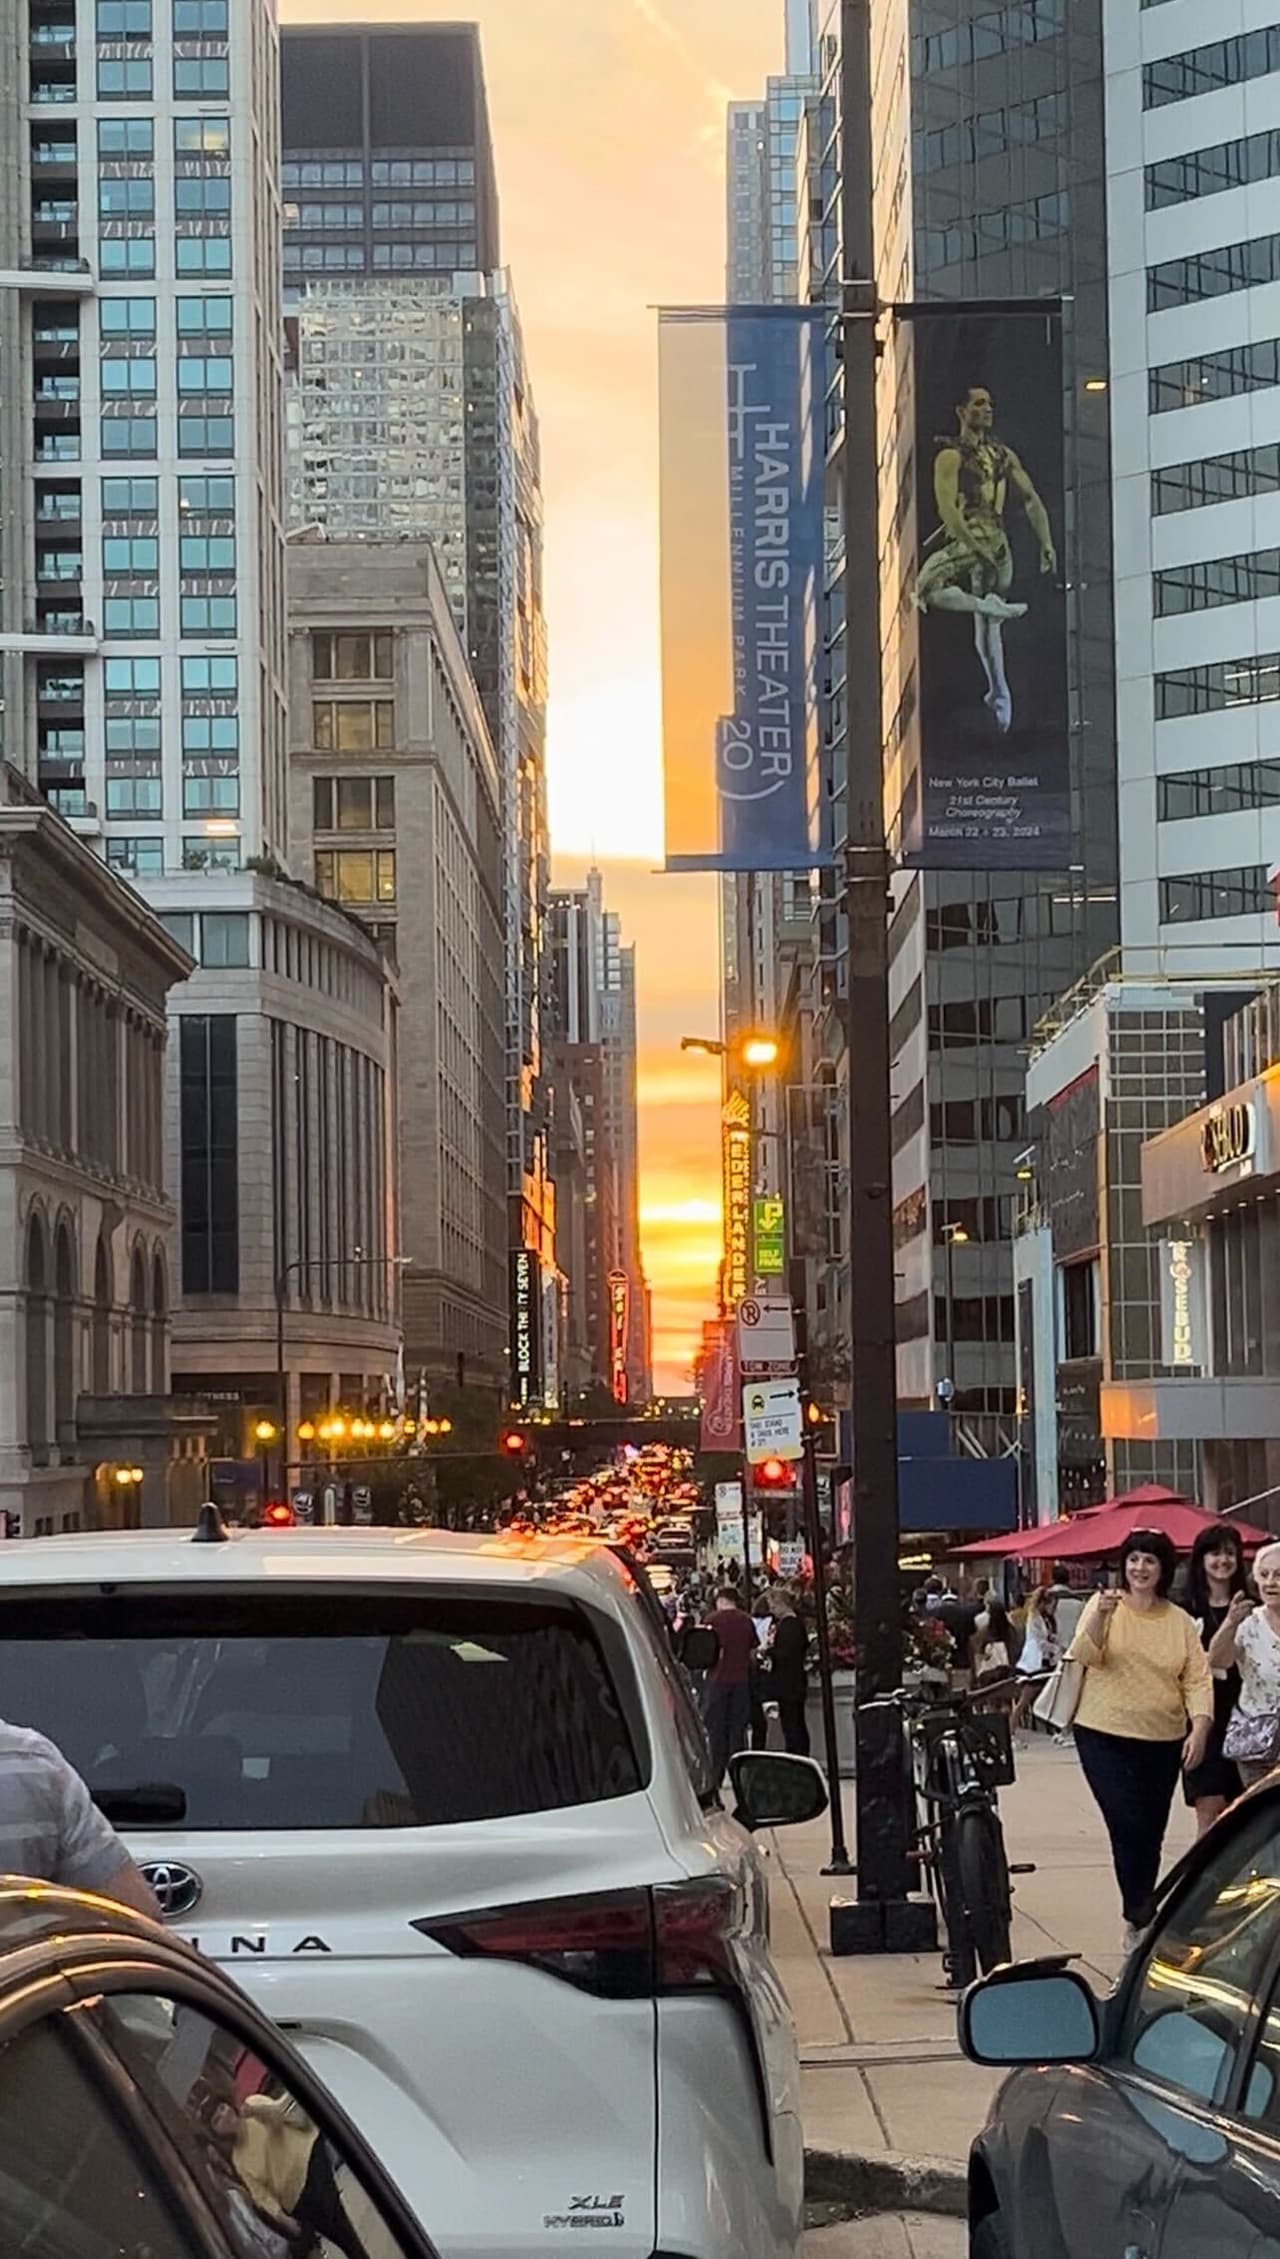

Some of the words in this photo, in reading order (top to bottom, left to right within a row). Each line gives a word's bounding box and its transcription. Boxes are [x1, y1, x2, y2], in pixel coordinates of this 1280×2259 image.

[754, 423, 790, 589] HARRIS
[730, 466, 745, 621] MILLENNIUM
[732, 635, 747, 696] PARK
[755, 595, 792, 777] THEATER
[929, 777, 953, 788] New
[956, 777, 980, 788] York
[982, 776, 1004, 789] City
[1007, 776, 1038, 787] Ballet
[949, 796, 973, 805] 21st
[976, 795, 1018, 806] Century
[928, 826, 963, 837] March
[945, 806, 1022, 820] Choreography
[516, 1253, 529, 1290] SEVEN
[517, 1291, 529, 1330] THITY
[1168, 1241, 1193, 1364] ROSEBUD
[517, 1333, 530, 1372] BLOCK
[568, 2195, 625, 2210] XLE
